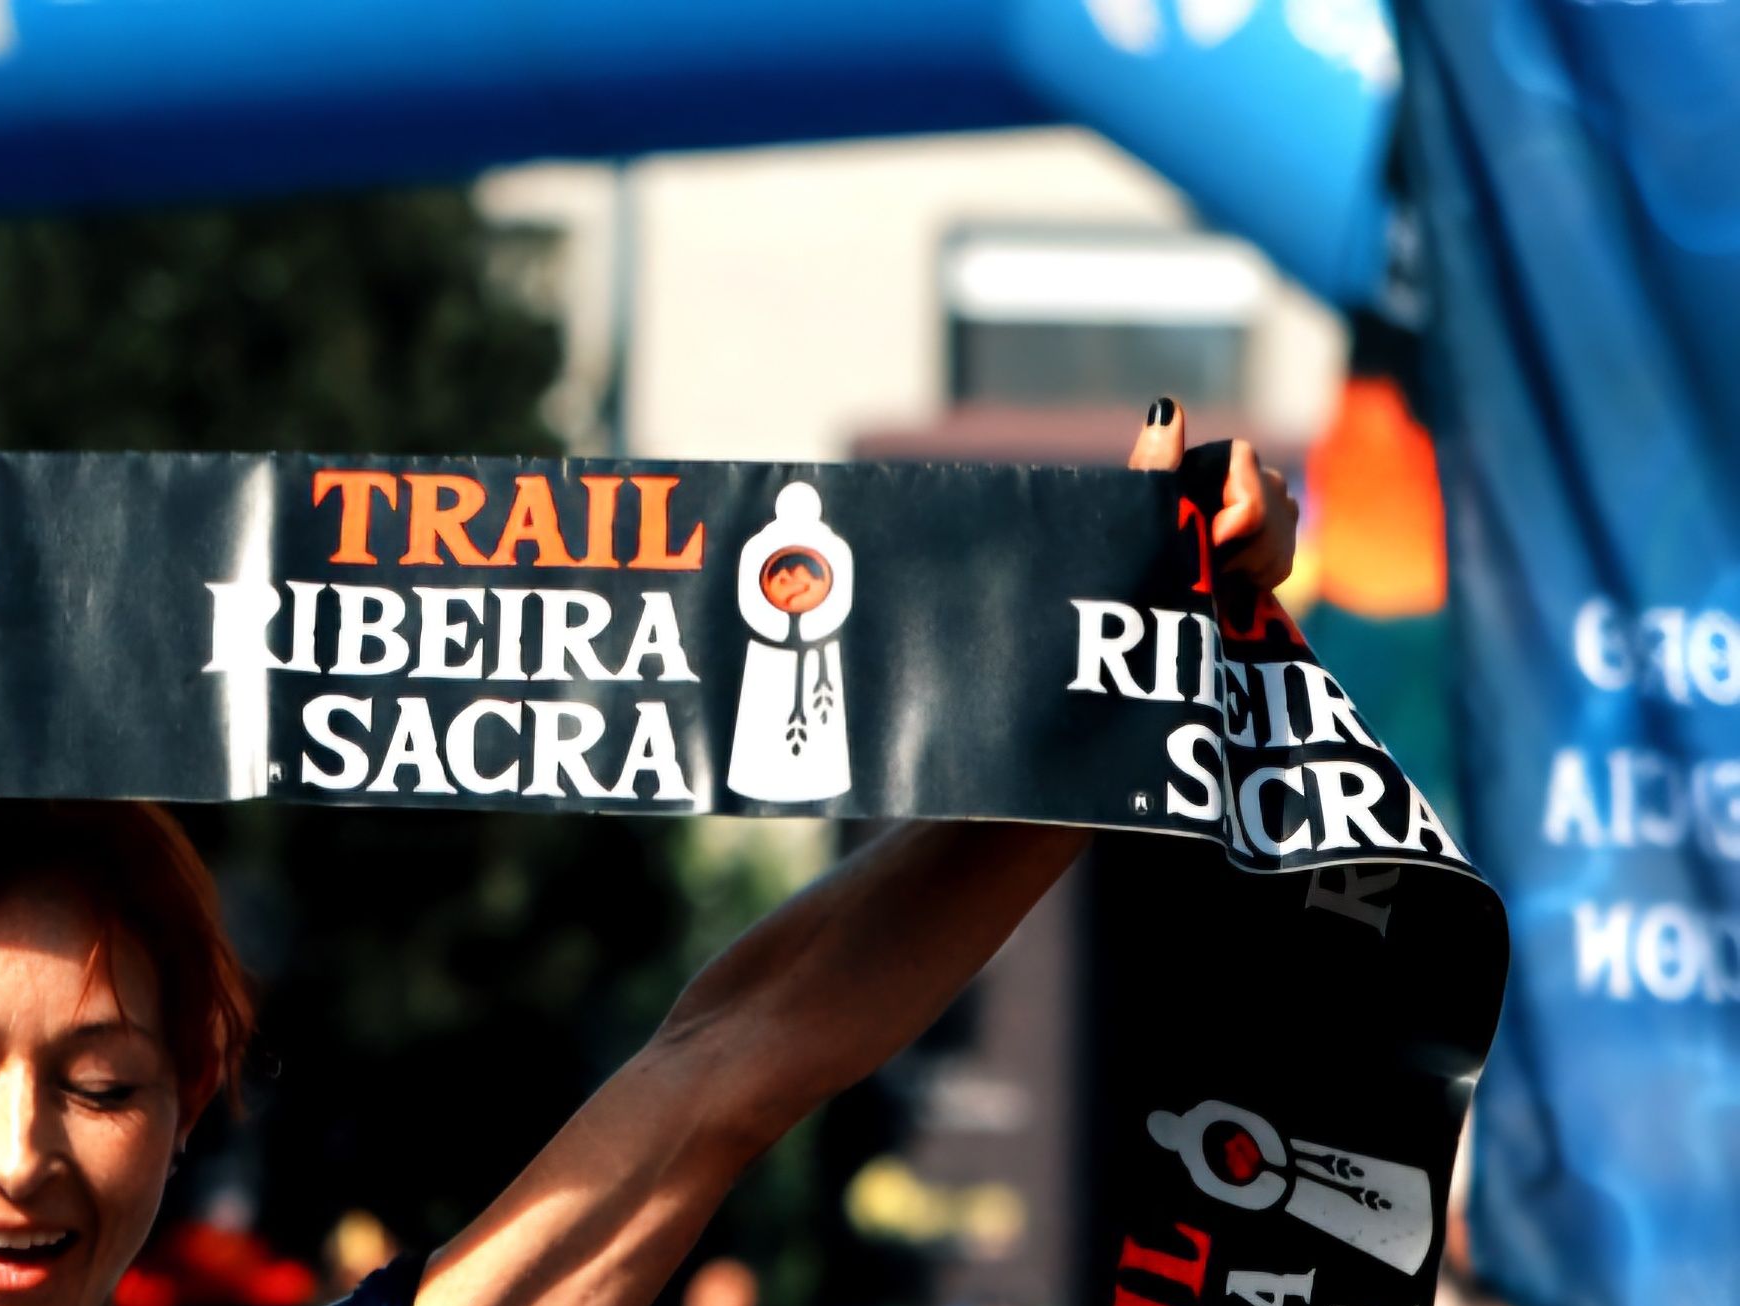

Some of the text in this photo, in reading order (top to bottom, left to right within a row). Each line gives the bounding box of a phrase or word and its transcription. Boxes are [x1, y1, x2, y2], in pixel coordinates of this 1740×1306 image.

[313, 468, 705, 572] TRAIL
[202, 580, 700, 683] RIBEIRA
[302, 694, 698, 800] SACRA
[1166, 724, 1472, 866] SCRA
